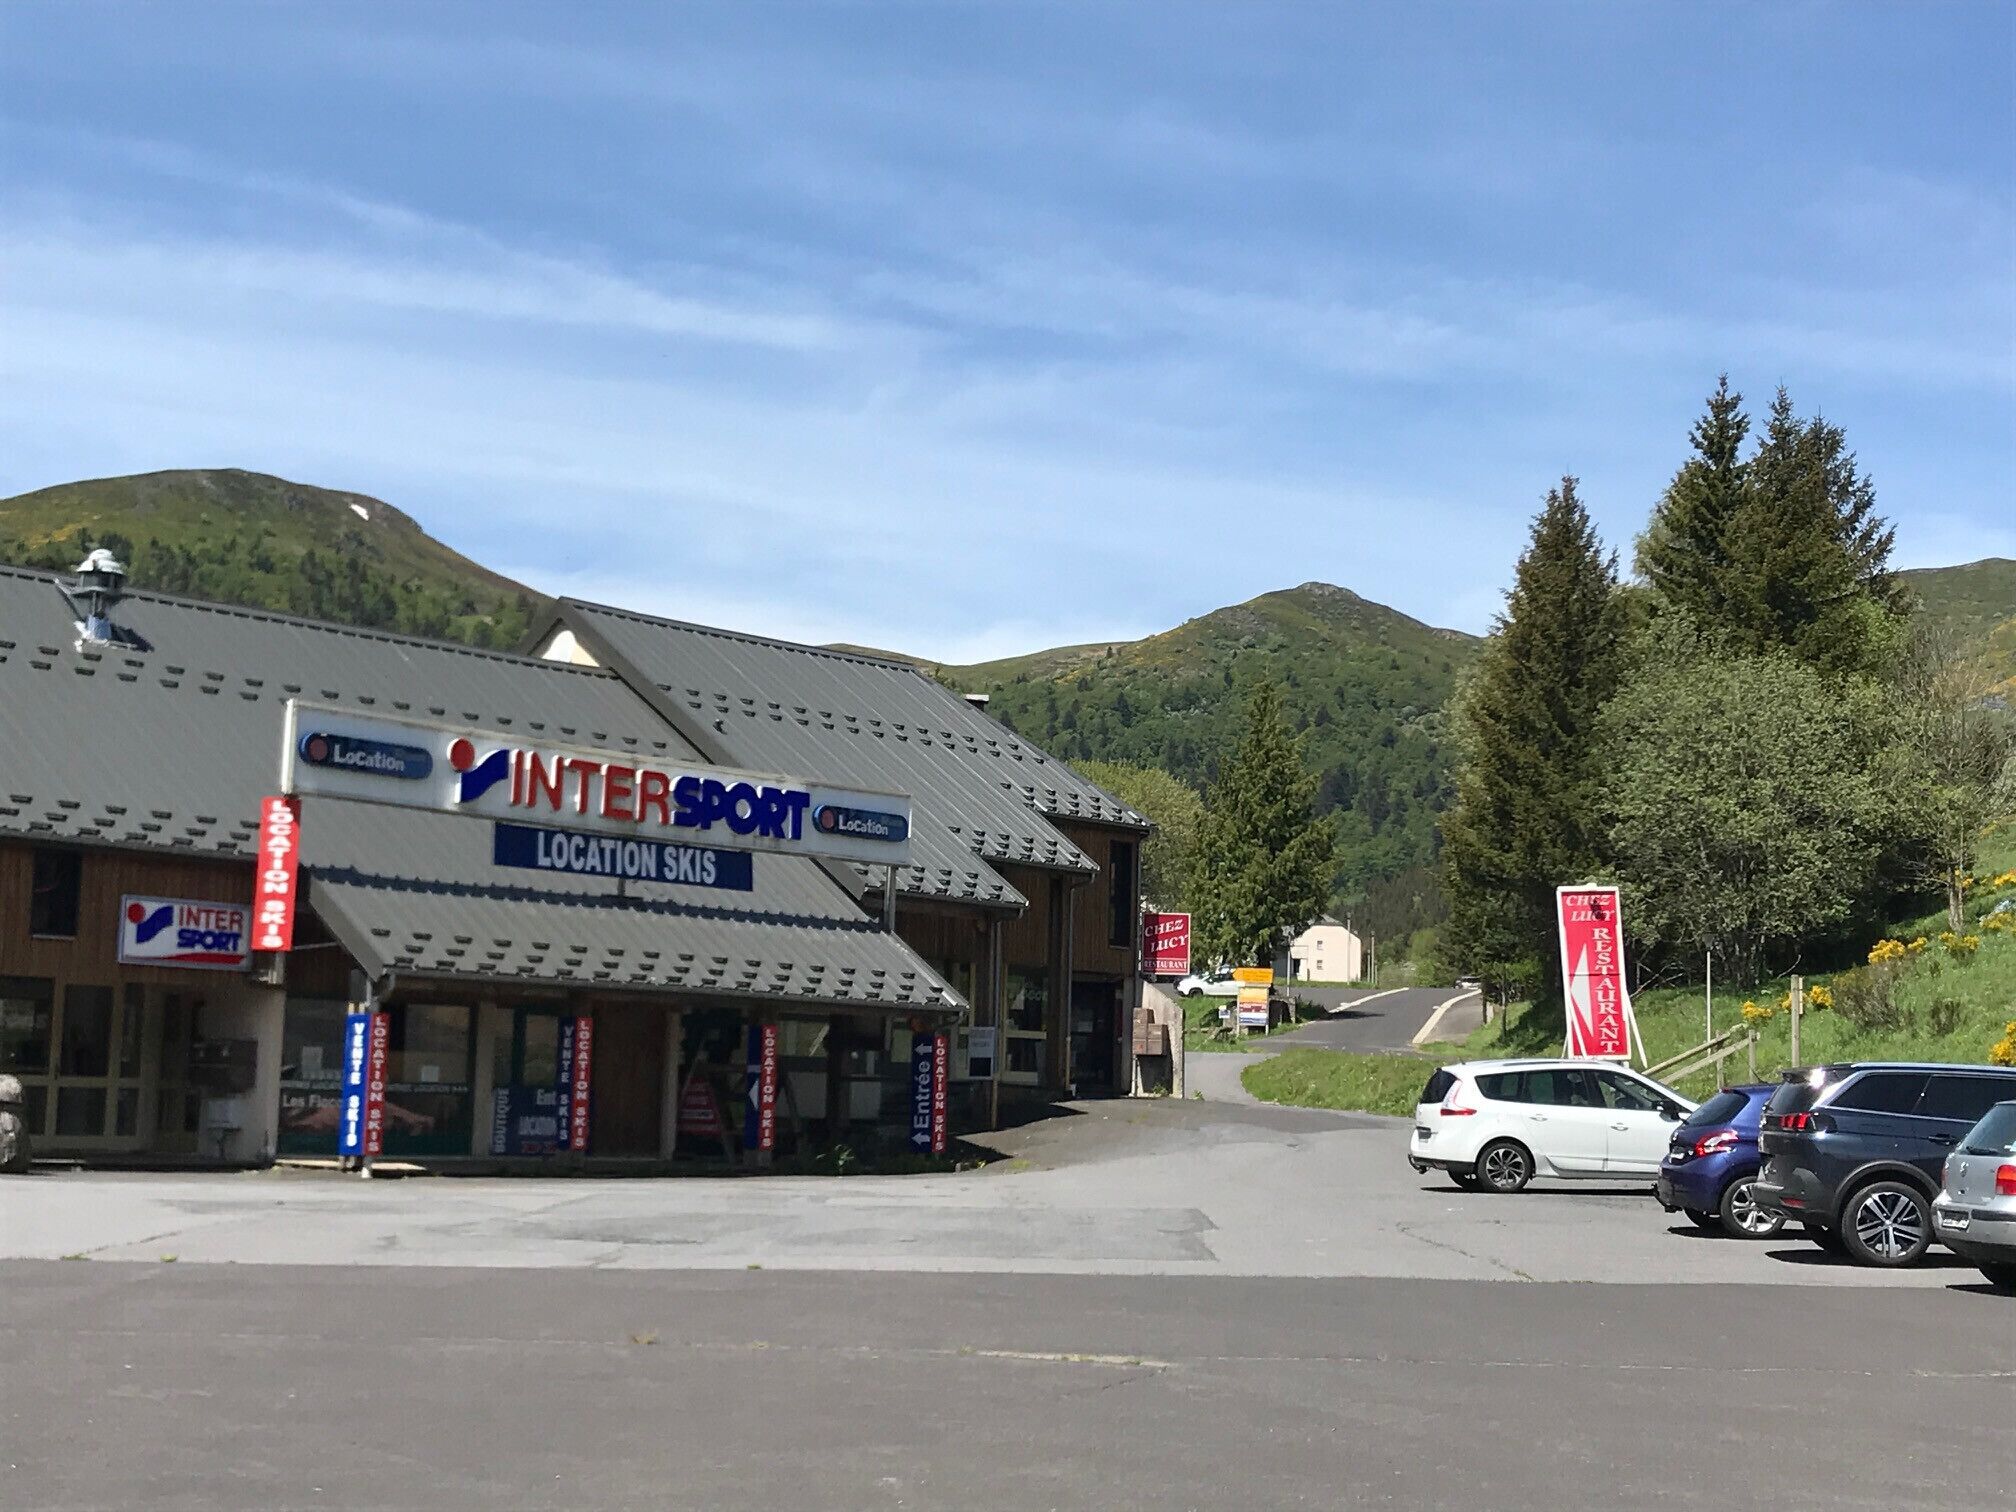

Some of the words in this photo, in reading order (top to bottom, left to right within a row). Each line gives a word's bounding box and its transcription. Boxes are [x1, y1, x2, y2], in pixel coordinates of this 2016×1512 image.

[510, 749, 810, 841] INTERSPORT
[263, 800, 294, 894] LOCATION
[536, 831, 656, 878] LOCATION
[663, 846, 717, 885] SKIS
[178, 905, 244, 931] INTER
[260, 900, 286, 948] SKIS
[1565, 894, 1611, 907] CHEZ
[177, 929, 242, 951] SPORT
[1144, 919, 1184, 937] CHEZ
[1151, 934, 1189, 953] LUCY
[1144, 961, 1187, 969] RESTAURANT
[1593, 928, 1620, 1053] RESTAURANT
[350, 1022, 365, 1085] VENTE
[370, 1016, 387, 1101] LOCATION
[560, 1025, 574, 1083] VENTE
[575, 1020, 591, 1100] LOCATION
[762, 1028, 775, 1103] LOCATION
[934, 1038, 946, 1109] LOCATION
[558, 1093, 570, 1140] SKIS
[913, 1060, 931, 1129] Entrée
[346, 1094, 360, 1147] SKIS
[368, 1108, 382, 1152] SKIS
[574, 1106, 587, 1147] SKIS
[761, 1109, 772, 1147] SKIS
[934, 1114, 945, 1151] SKIS
